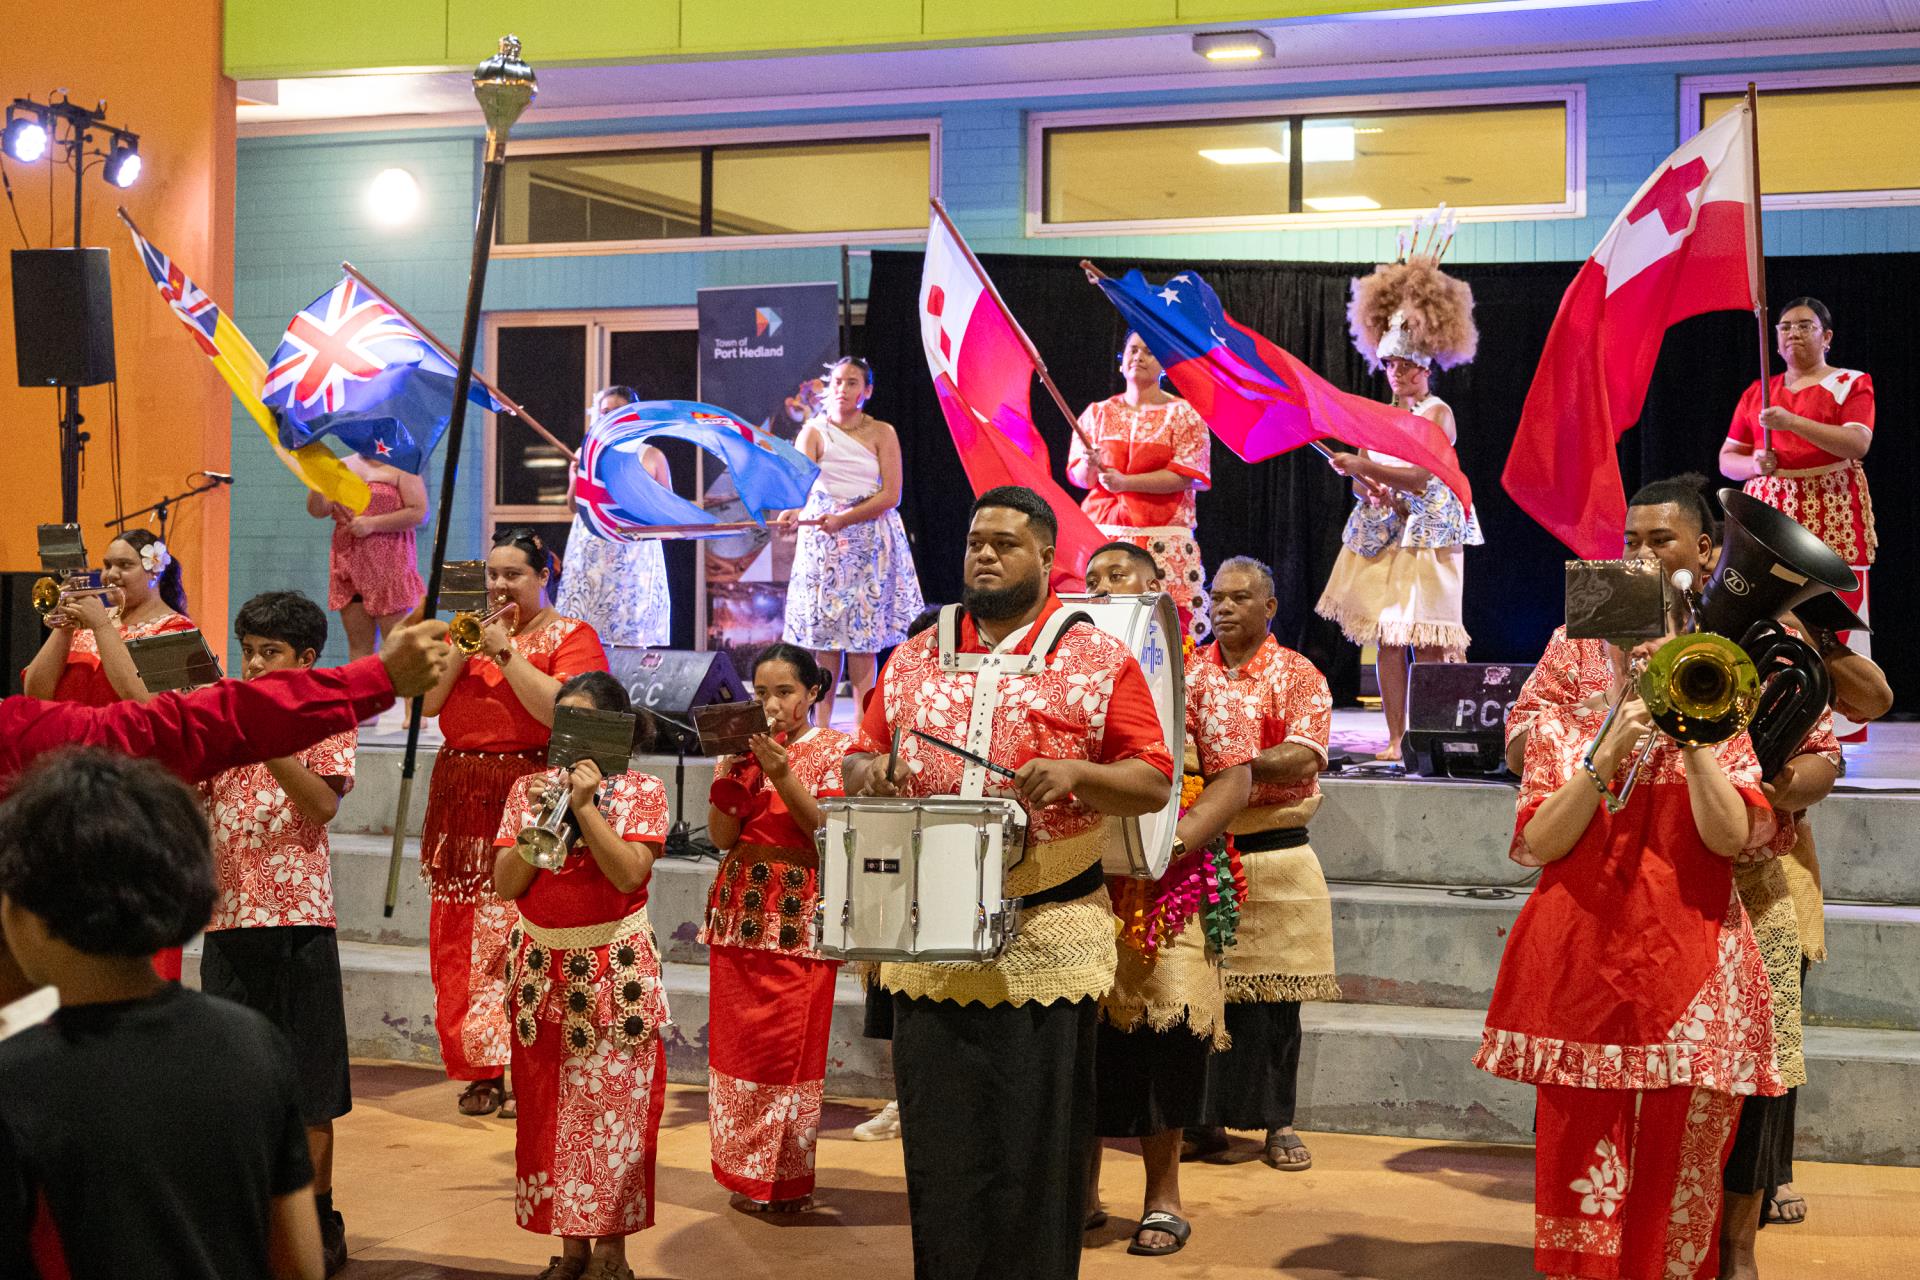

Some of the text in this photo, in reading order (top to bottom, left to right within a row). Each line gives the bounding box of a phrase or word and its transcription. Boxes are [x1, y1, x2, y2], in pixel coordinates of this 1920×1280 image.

[714, 337, 748, 347] Town of
[714, 344, 784, 359] Port Hedland
